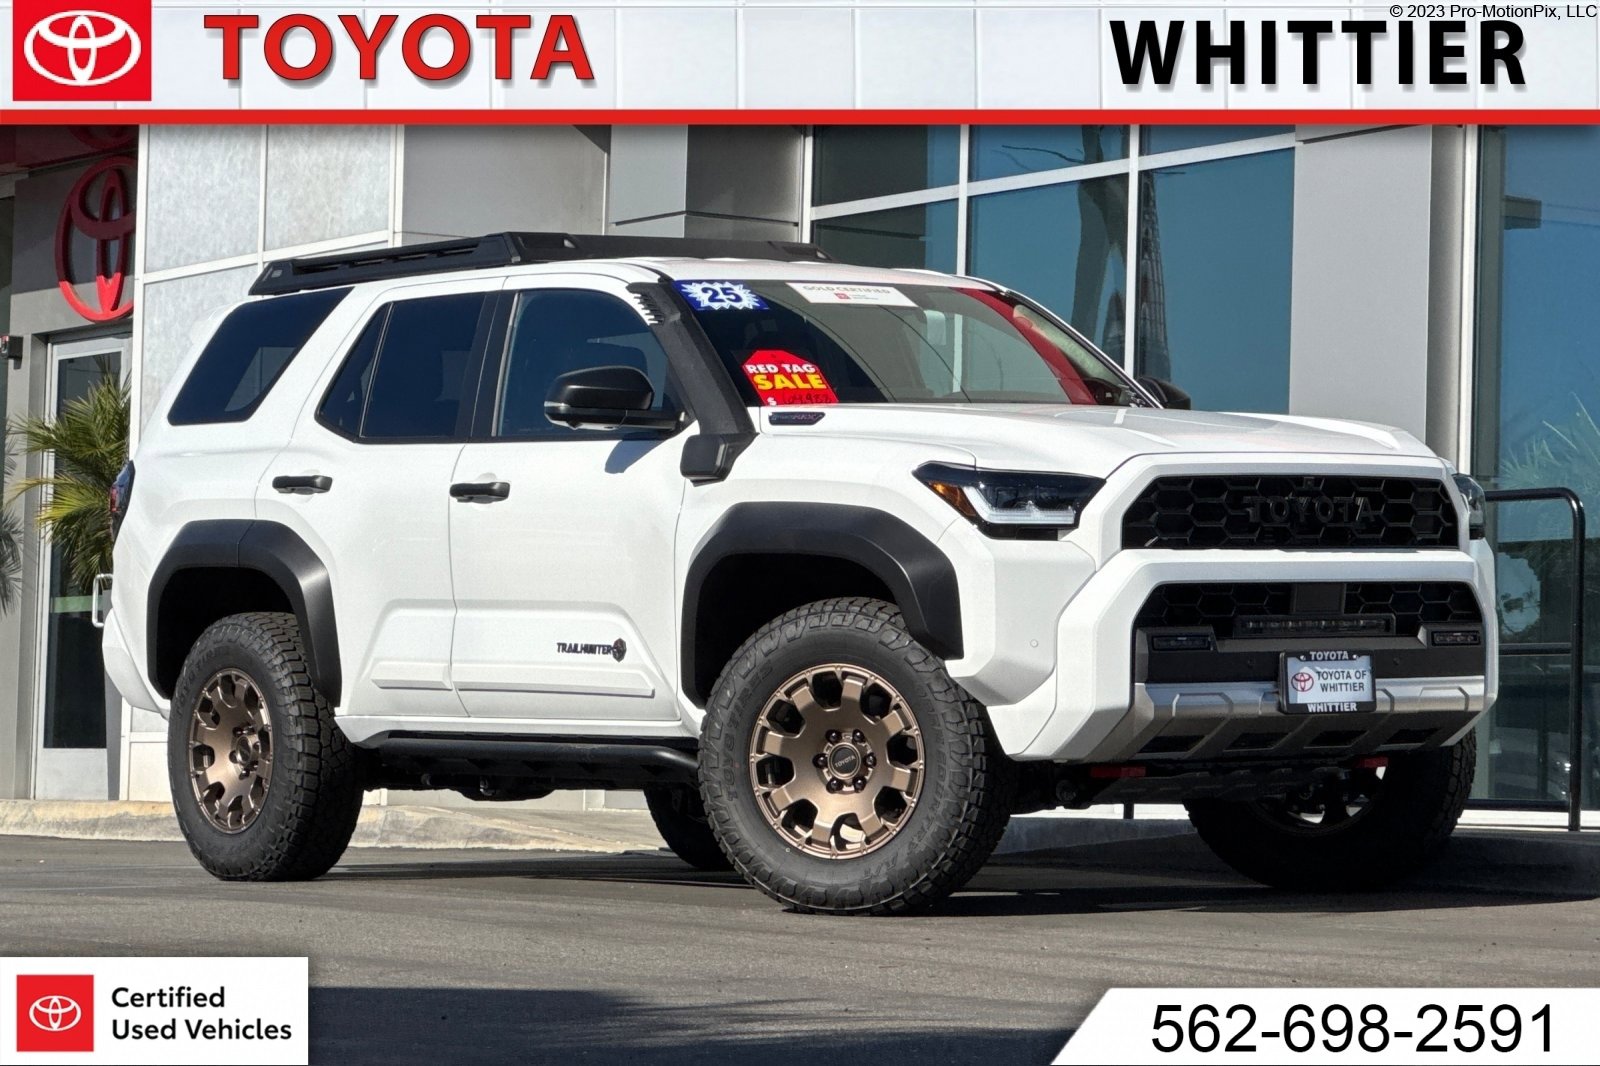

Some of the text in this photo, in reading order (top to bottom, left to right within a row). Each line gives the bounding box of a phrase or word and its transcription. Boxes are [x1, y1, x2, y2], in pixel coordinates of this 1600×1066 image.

[701, 286, 743, 303] 25
[745, 364, 816, 374] RED TAG
[753, 373, 827, 390] SALE
[1242, 496, 1375, 523] TOYOTA
[557, 642, 614, 655] TRAILHUNTER
[1309, 650, 1349, 661] TOYOTA
[1316, 670, 1367, 681] TOYOTA OF
[1320, 682, 1365, 692] WHITTIER
[1307, 702, 1358, 713] WHITTIER
[834, 755, 856, 768] TOYOTA
